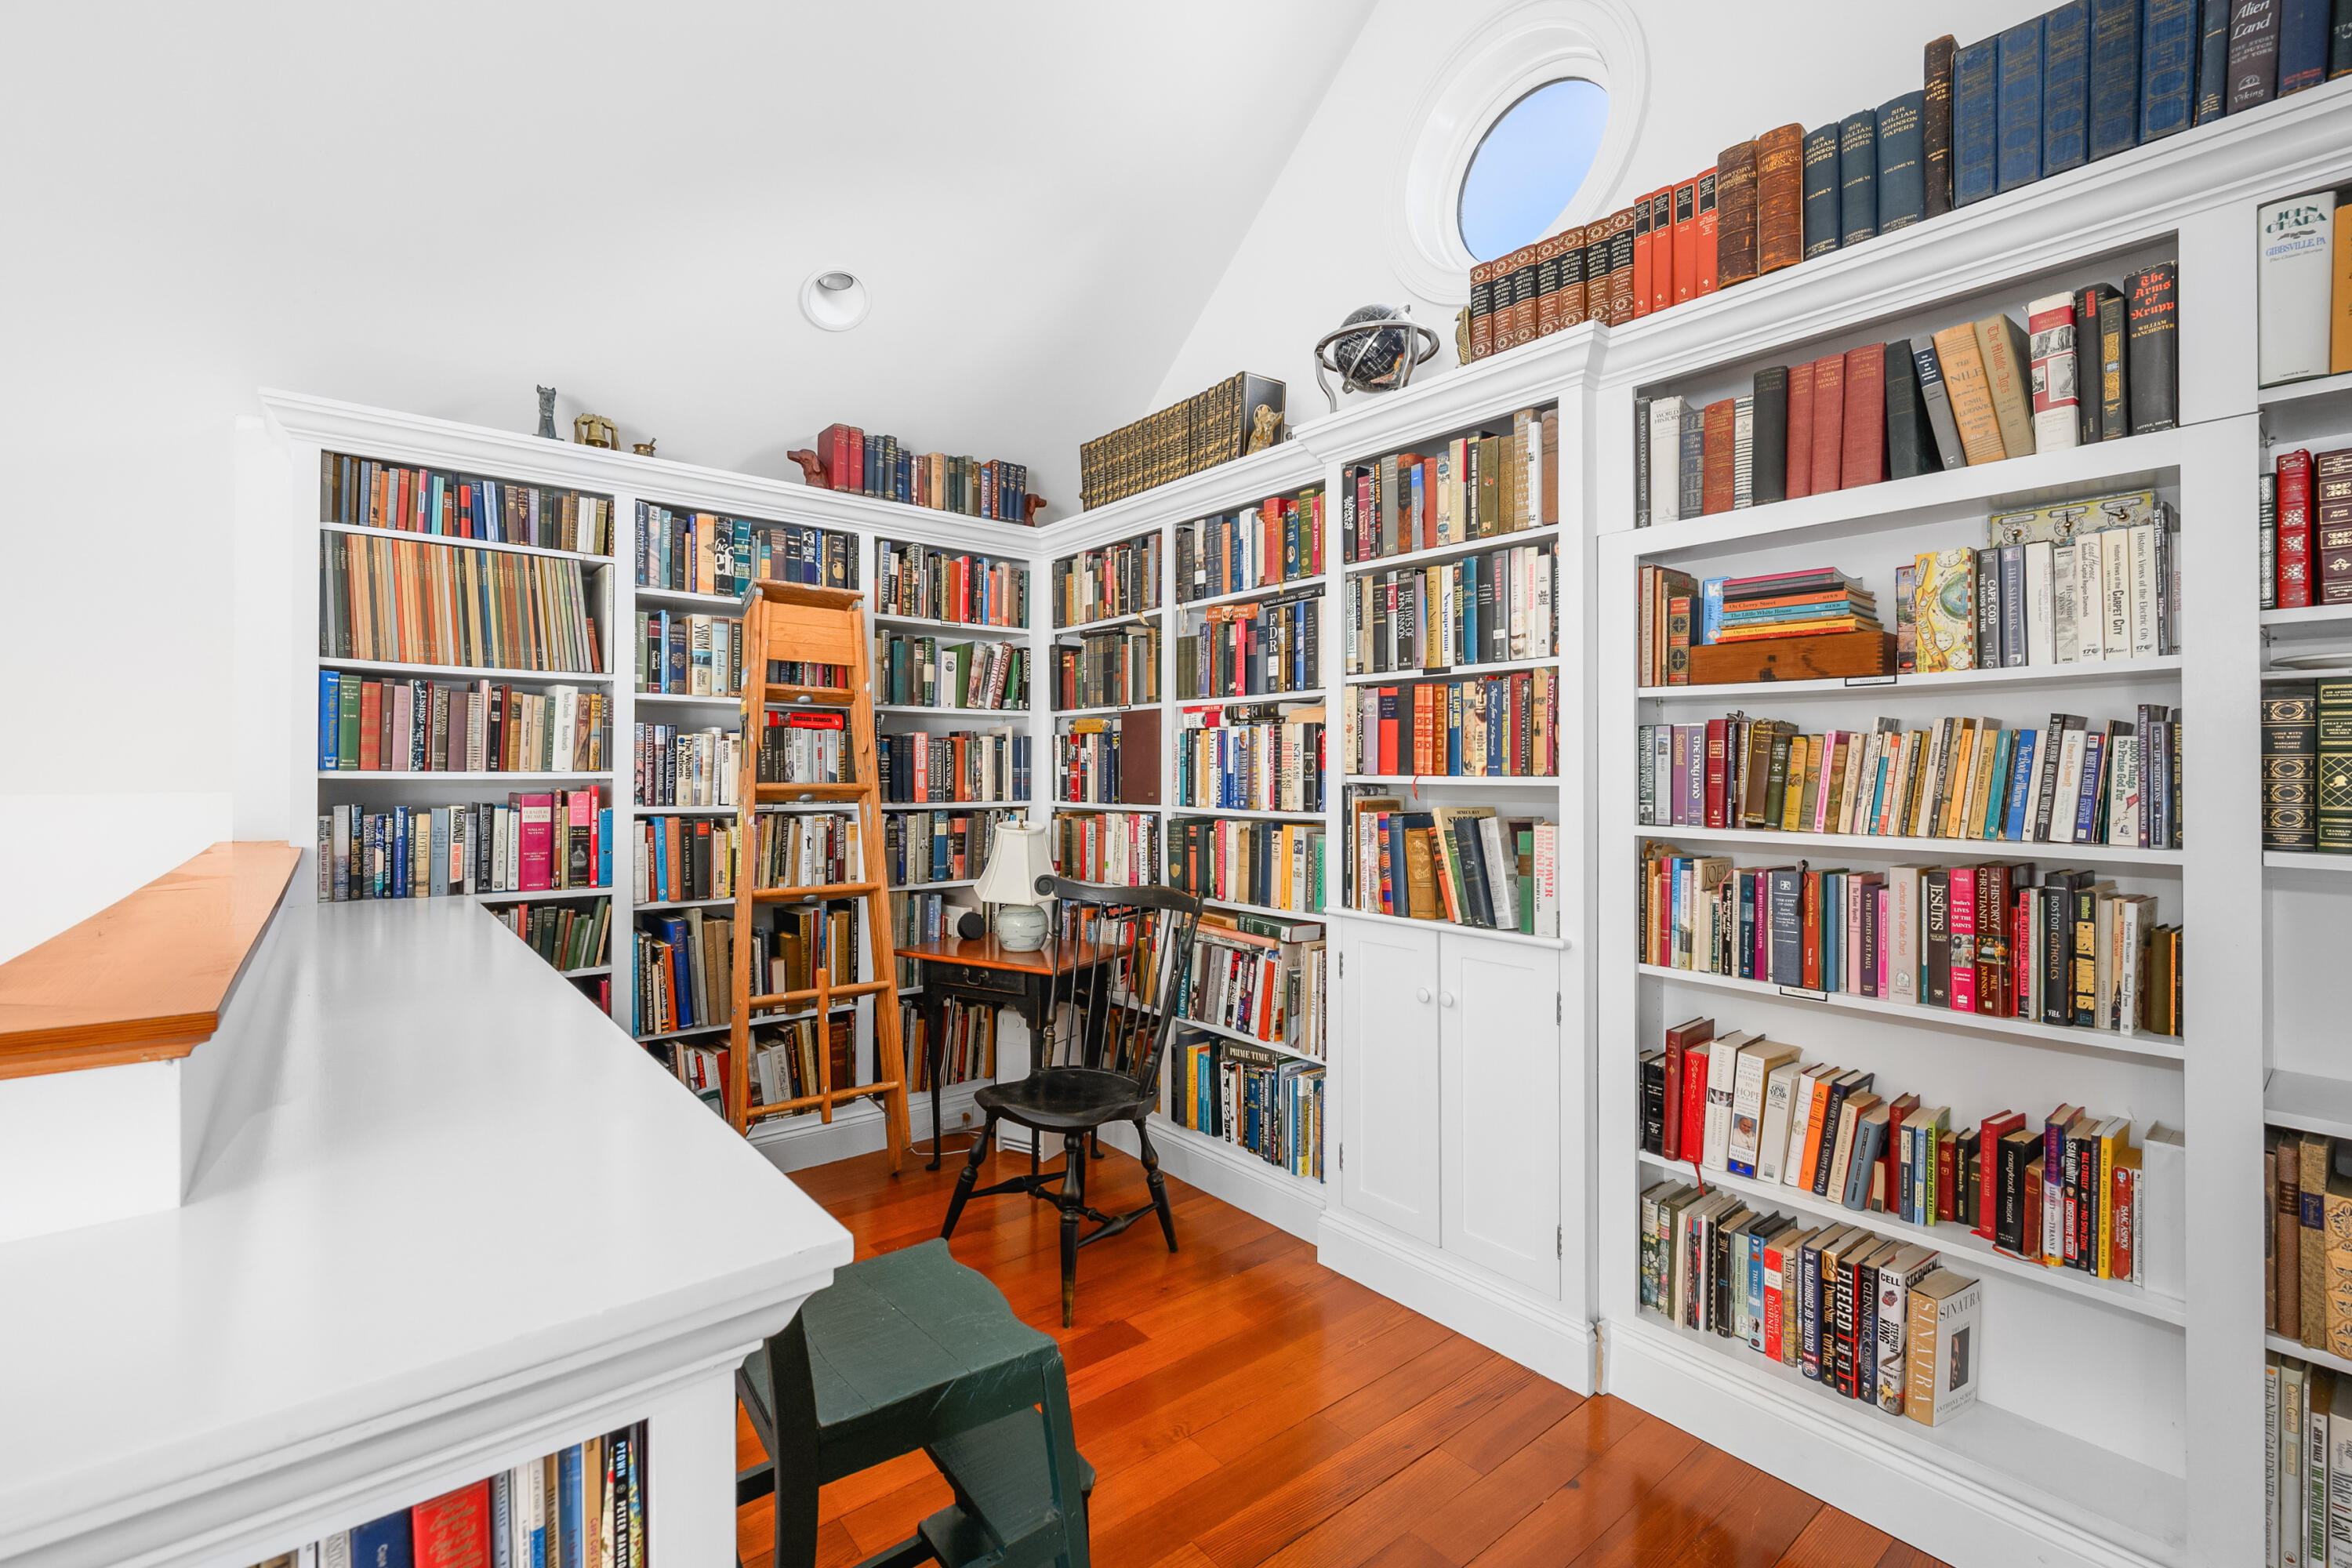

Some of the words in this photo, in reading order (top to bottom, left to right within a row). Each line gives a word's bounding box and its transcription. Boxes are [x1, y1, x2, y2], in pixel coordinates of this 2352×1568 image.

[2232, 0, 2270, 24] Alien
[2232, 13, 2272, 39] Land
[1926, 87, 1946, 100] STATE
[2234, 89, 2264, 103] Viking
[1849, 122, 1861, 131] SIR
[1881, 116, 1918, 133] JOHNSON
[1882, 110, 1917, 126] WILLIAM
[1813, 136, 1824, 145] SIR
[1883, 123, 1915, 138] PAPERS
[1762, 149, 1795, 164] HISTORY
[1843, 139, 1870, 154] PAPERS
[1806, 152, 1833, 168] PAPERS
[1884, 164, 1906, 174] VOLUME
[1721, 165, 1751, 181] HISTORY
[2277, 204, 2318, 221] JOHN
[2266, 213, 2327, 234] O'HARA
[1588, 248, 1607, 256] DECLINE
[1612, 238, 1631, 247] DECLINE
[2266, 238, 2315, 257] GIBBSVILLE,
[2317, 235, 2326, 245] PA
[1562, 256, 1581, 264] DECLINE
[1613, 259, 1630, 267] EMPIRE
[1563, 276, 1579, 285] EMPIRE
[1589, 269, 1606, 278] EMPIRE
[2140, 272, 2165, 288] The
[2133, 279, 2171, 301] Arms
[2145, 293, 2158, 306] of
[2130, 302, 2175, 320] Krupp
[1987, 323, 1999, 343] The
[2132, 323, 2175, 338] MANCHESTER
[2137, 320, 2167, 331] WILLIAM
[1991, 343, 2007, 371] Middle
[1950, 366, 1985, 385] NILE
[2137, 532, 2146, 558] Historic
[2008, 566, 2016, 586] THE
[2138, 560, 2147, 577] Views
[1454, 585, 1463, 617] RHODES
[1987, 579, 1996, 602] CAPE
[2008, 589, 2018, 630] SHAKERS
[2113, 590, 2124, 617] CARPET
[2139, 600, 2148, 626] Electric
[695, 623, 710, 649] SARUM
[1406, 628, 1414, 637] OF
[2113, 619, 2125, 635] CITY
[2140, 627, 2148, 641] City
[989, 659, 1000, 692] BRITONS
[1676, 734, 1685, 765] Scotland
[2118, 740, 2128, 750] To
[1239, 751, 1247, 779] BARBARA
[2118, 750, 2127, 771] Praise
[2116, 772, 2126, 786] God
[2126, 763, 2139, 789] Things
[2013, 782, 2027, 808] Mormon
[2115, 786, 2126, 800] For
[1929, 884, 1946, 931] JESUITS
[1979, 868, 1987, 931] CHRISTIANITY
[1991, 885, 1999, 920] HISTORY
[2081, 896, 2090, 919] Wilhelm
[2050, 895, 2060, 930] BOSTON
[2077, 921, 2095, 956] CHRIST
[2050, 931, 2060, 980] CATHOLICS
[2076, 957, 2095, 994] AMONG
[2077, 996, 2095, 1011] US
[1229, 1047, 1249, 1057] PRIME
[1251, 1050, 1270, 1062] TIME
[1691, 1059, 1700, 1099] WORSHIP
[1771, 1085, 1787, 1094] ONE
[1736, 1087, 1760, 1099] HOPE
[1769, 1089, 1788, 1099] YEAR
[1831, 1093, 1839, 1116] MOTHER
[1826, 1116, 1835, 1138] TERESA
[1731, 1152, 1754, 1163] WEIGEL
[1820, 1149, 1829, 1168] SIMPLE
[2067, 1141, 2076, 1159] SEAN
[2066, 1156, 2076, 1185] HANNITY
[2066, 1200, 2074, 1233] CONSERVATIVE
[1786, 1255, 1795, 1285] Marsh
[1880, 1272, 1900, 1287] CELL
[1805, 1265, 1814, 1312] CORRUPTION
[1863, 1282, 1874, 1316] GLENN
[1837, 1269, 1853, 1331] FLEECED
[1939, 1292, 1981, 1321] SINATRA
[1766, 1294, 1775, 1339] BUSHNELL
[1805, 1312, 1813, 1323] OF
[1804, 1325, 1813, 1352] CULTURE
[1863, 1318, 1874, 1344] BECK
[1879, 1318, 1889, 1345] KING
[1889, 1322, 1899, 1353] STEPHEN
[1915, 1299, 1936, 1402] SINATRA
[2265, 1377, 2276, 1401] THE
[2265, 1404, 2276, 1432] NEW
[616, 1441, 626, 1478] PTOWN
[616, 1501, 626, 1532] PETER
